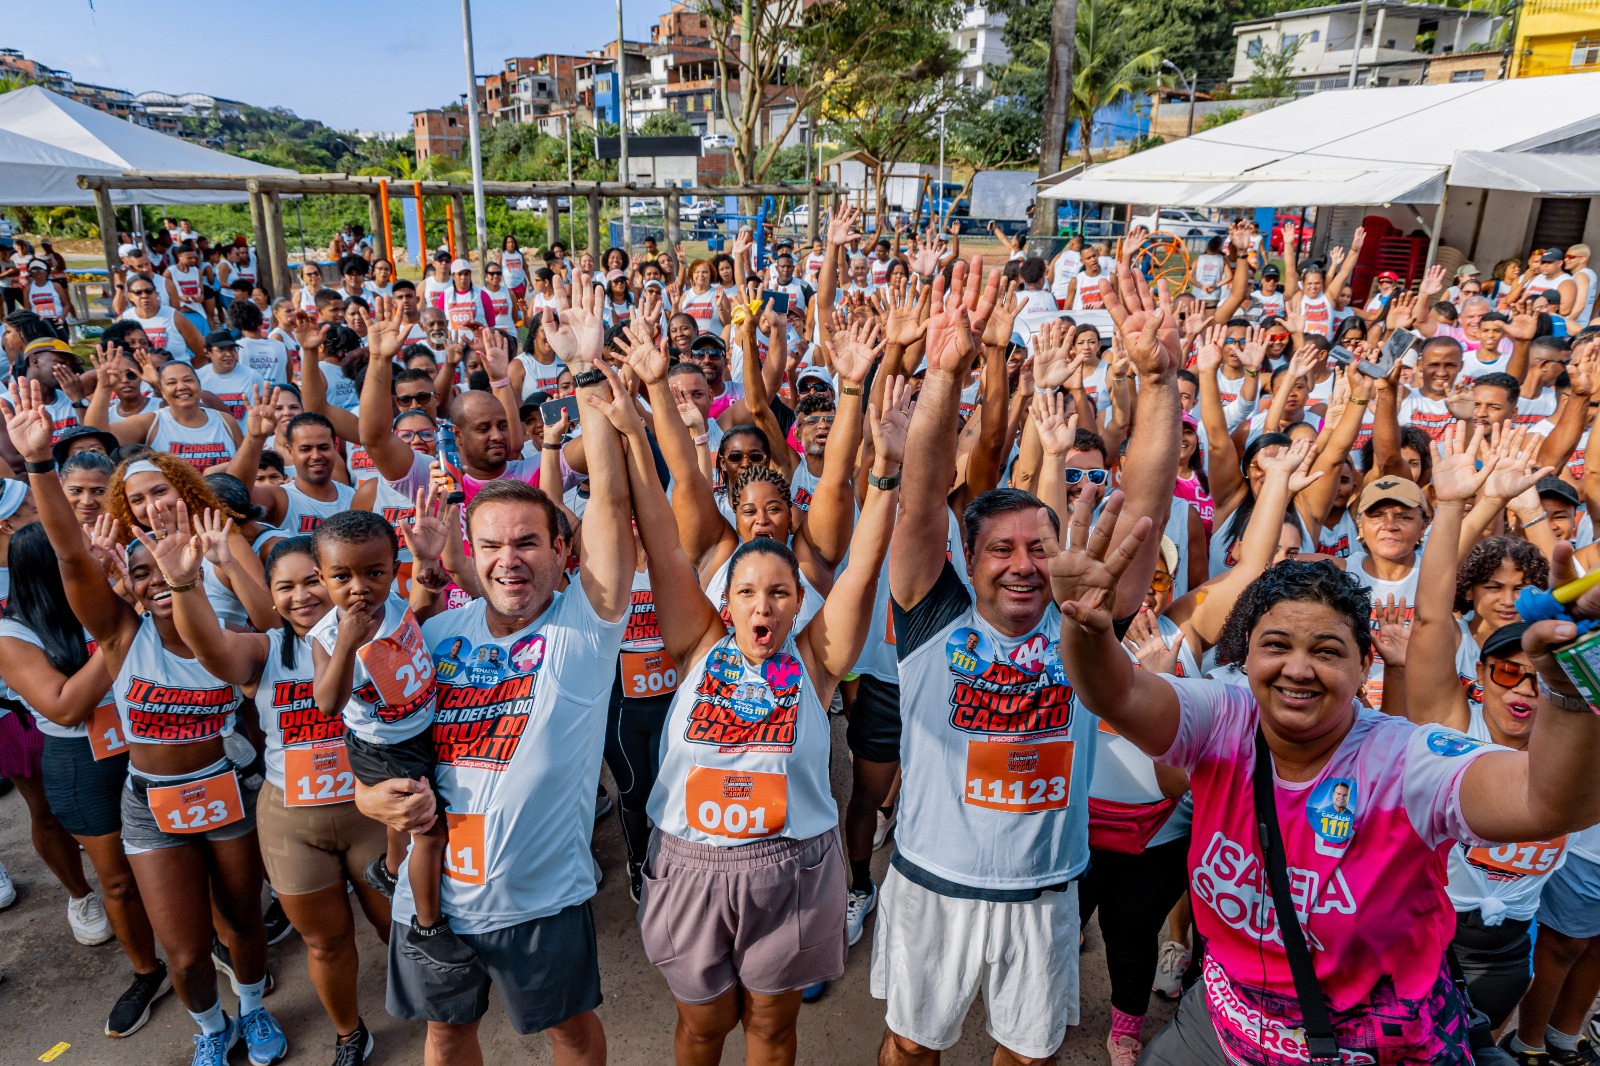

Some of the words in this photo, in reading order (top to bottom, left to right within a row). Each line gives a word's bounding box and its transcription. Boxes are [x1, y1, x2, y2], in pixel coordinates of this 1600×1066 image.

[627, 613, 658, 628] QUE
[436, 661, 458, 676] 1111
[951, 651, 977, 671] 1111
[443, 675, 533, 708] CORRIDA
[470, 674, 499, 685] 11123
[632, 668, 677, 694] 300
[147, 686, 234, 706] CORRIDA
[292, 699, 313, 711] EM
[955, 684, 1036, 714] DIQUE
[1039, 685, 1073, 707] DO
[129, 709, 203, 727] DIQUE
[143, 702, 166, 713] EM
[167, 703, 218, 715] DEFESA
[458, 701, 512, 722] DEFESA
[513, 698, 533, 714] DO
[954, 704, 1069, 732] CABRITO
[131, 719, 226, 740] CABRITO
[495, 715, 529, 736] DO
[687, 720, 795, 744] CABRITO
[297, 772, 355, 801] 122
[968, 777, 1066, 804] 11123
[166, 800, 228, 829] 123
[698, 800, 770, 834] 001
[1321, 817, 1350, 837] 1111
[1488, 842, 1560, 871] 015
[1205, 836, 1350, 914] ISAELA
